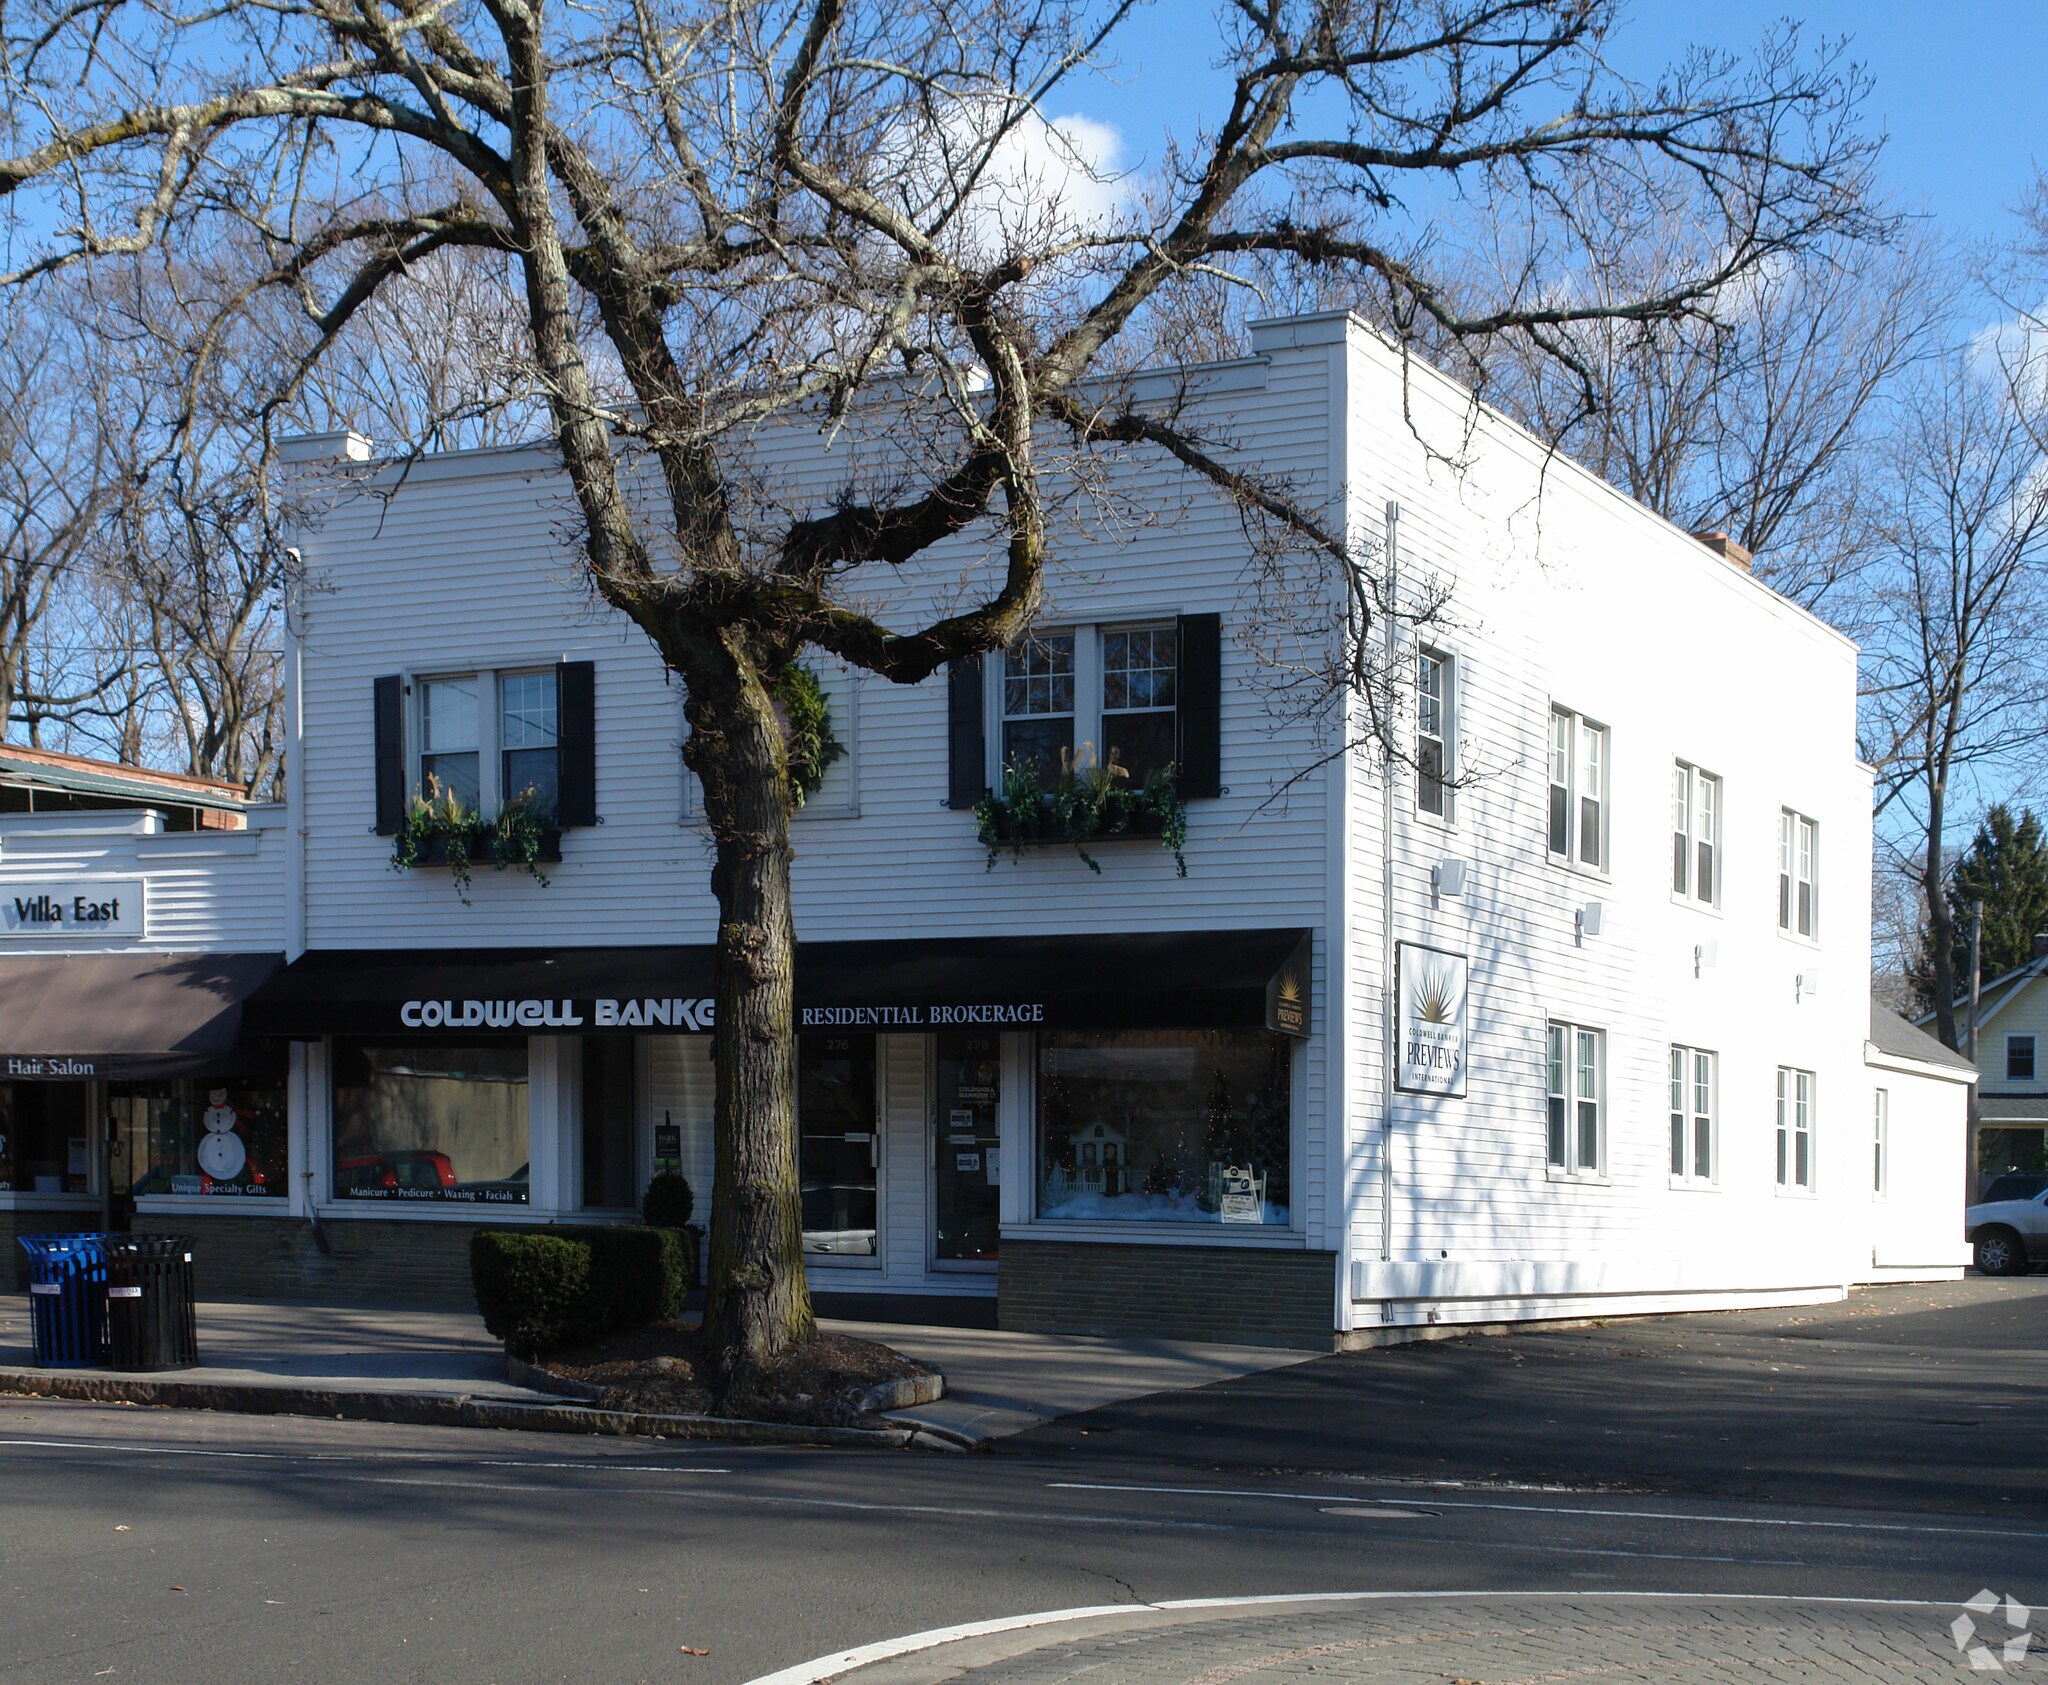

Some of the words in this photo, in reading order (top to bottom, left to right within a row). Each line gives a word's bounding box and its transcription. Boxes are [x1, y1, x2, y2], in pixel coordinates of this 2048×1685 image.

[15, 896, 62, 922] Villa
[74, 896, 120, 922] East
[400, 1000, 583, 1027] COLDWELL
[595, 999, 715, 1031] BANKE
[802, 1006, 923, 1025] RESIDENTIAL
[929, 1004, 1044, 1024] BROKERAGE
[1409, 1027, 1436, 1040] COLDWELL
[1437, 1032, 1458, 1043] BANKER
[826, 1040, 849, 1050] 276
[1407, 1041, 1460, 1072] PREVIEWS
[8, 1058, 44, 1075] Hair
[48, 1058, 95, 1075] Salon
[1411, 1071, 1454, 1085] INTERNATIONAL
[171, 1182, 202, 1194] Unique
[204, 1183, 243, 1196] Specialty
[246, 1184, 267, 1194] Gifts
[350, 1187, 388, 1197] Manicure
[398, 1187, 434, 1198] Pedicure
[444, 1188, 475, 1201] Waxing
[486, 1190, 513, 1200] Facials
